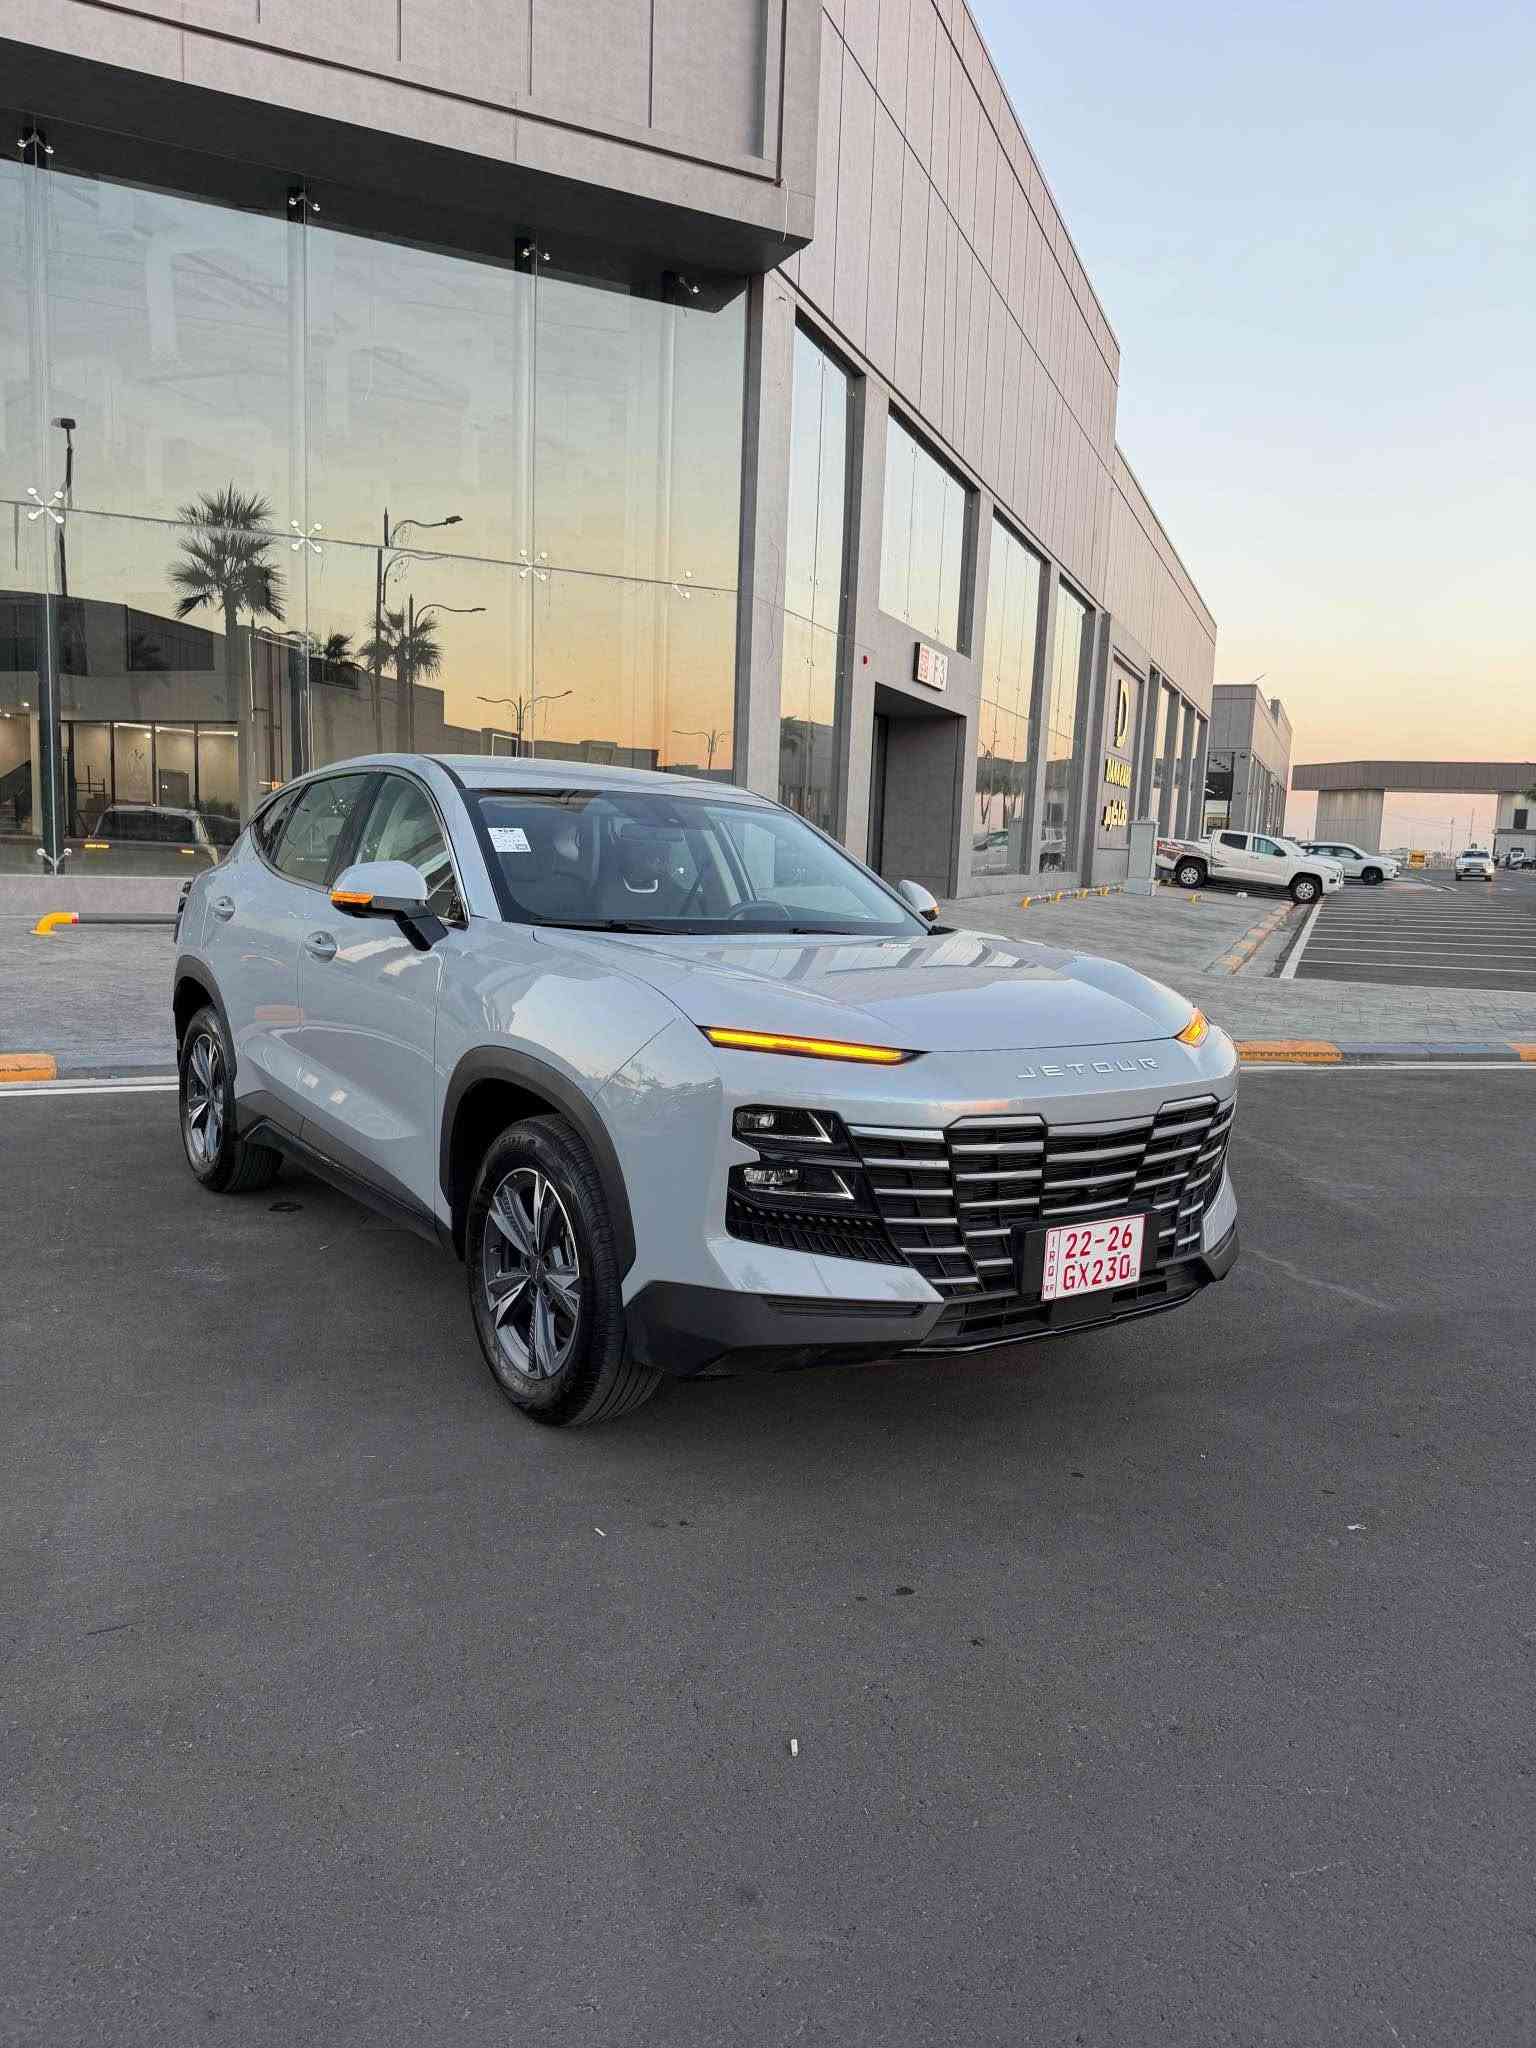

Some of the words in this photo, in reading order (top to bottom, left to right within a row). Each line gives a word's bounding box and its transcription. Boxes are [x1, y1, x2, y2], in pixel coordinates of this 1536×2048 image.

[1116, 679, 1129, 747] D
[1016, 1058, 1159, 1078] JETOUR
[1065, 1224, 1132, 1259] 22-26
[1063, 1254, 1130, 1290] GX230
